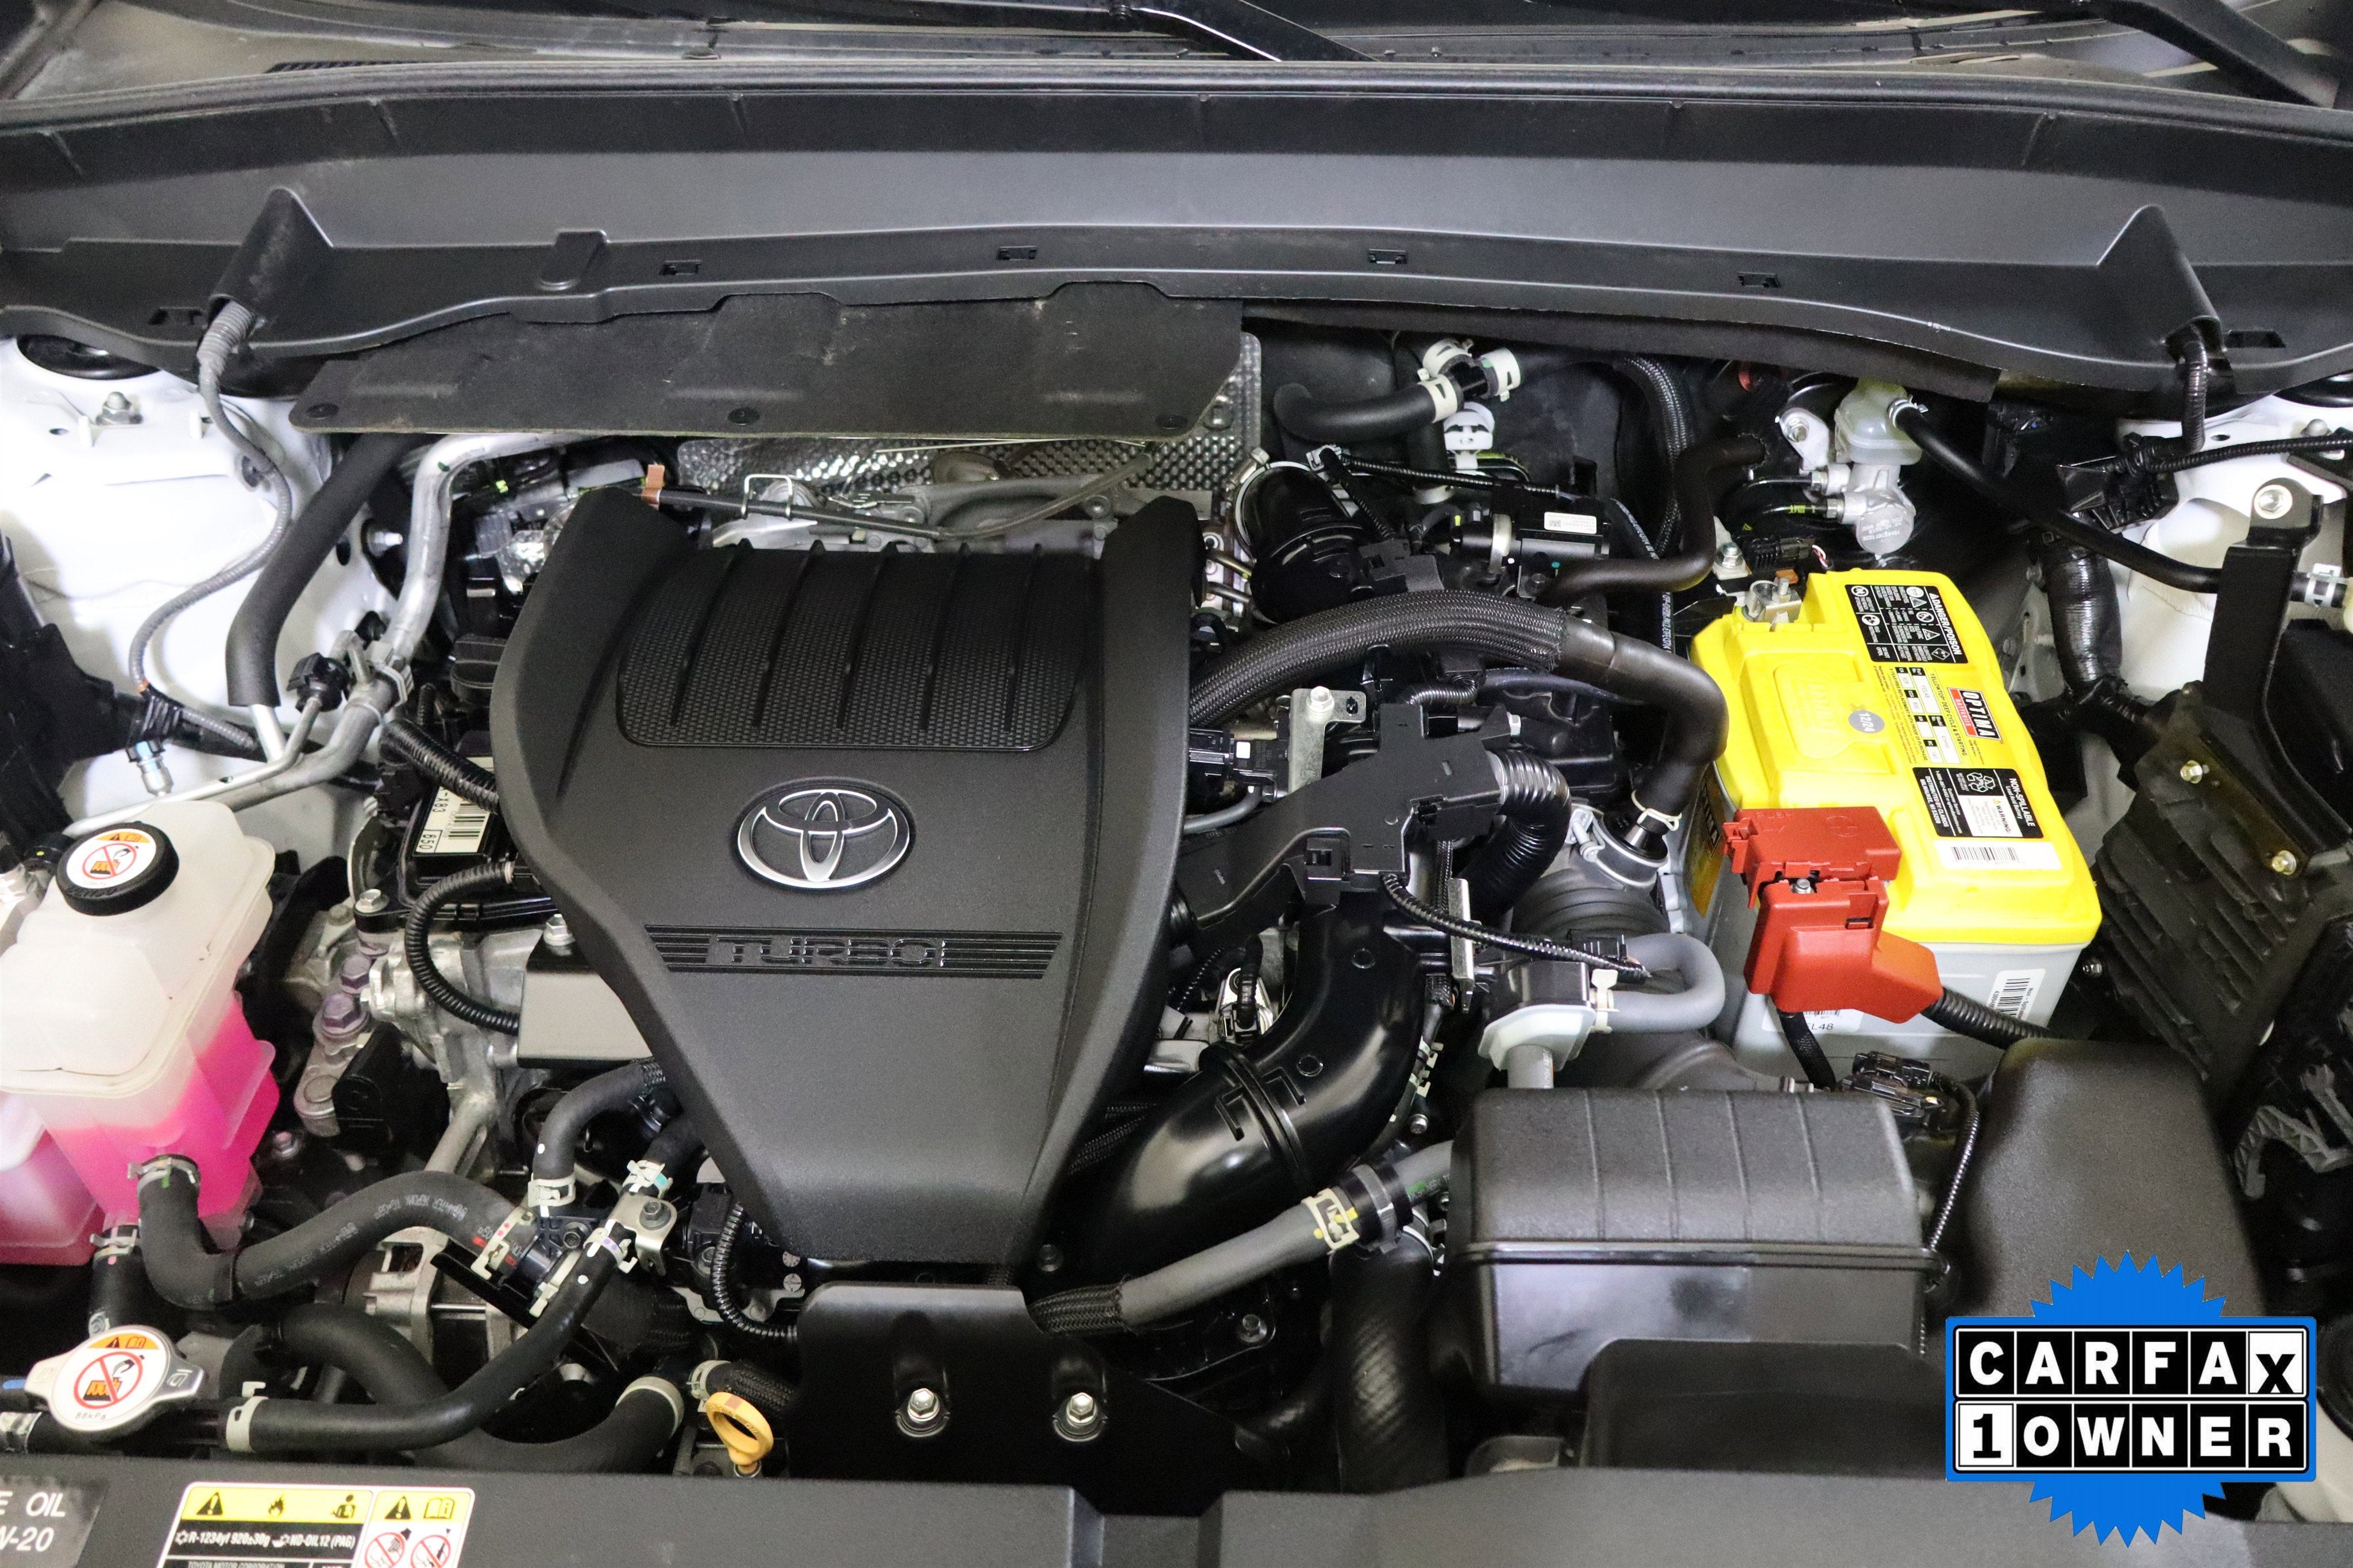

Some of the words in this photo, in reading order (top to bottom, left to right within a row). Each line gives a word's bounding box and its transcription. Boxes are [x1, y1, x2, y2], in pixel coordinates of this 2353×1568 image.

[1931, 599, 1962, 655] DANGER/POISON
[1896, 689, 1911, 713] REPLACEMENT
[1954, 698, 1972, 727] BATTERIES
[1961, 691, 1996, 736] OPTIMA
[1859, 712, 1874, 733] 12/24
[1941, 701, 1951, 713] DEEP
[1946, 714, 1957, 728] CYCLE
[1953, 733, 1968, 755] STARTING
[1919, 779, 1934, 804] MILWAUKEE,
[1924, 775, 1939, 802] DISTRIBUTED
[1937, 809, 1949, 827] CLARIOS
[1946, 787, 1957, 803] Customer
[1952, 802, 1962, 815] Service
[2005, 786, 2014, 795] Lead
[2008, 778, 2035, 827] NON-SPILLABLE
[2009, 795, 2018, 804] Acid
[2011, 804, 2023, 819] Battery
[419, 834, 437, 849] 650
[716, 935, 937, 965] TURBO
[26, 1492, 66, 1517] OIL
[330, 1534, 356, 1550] (PAG)
